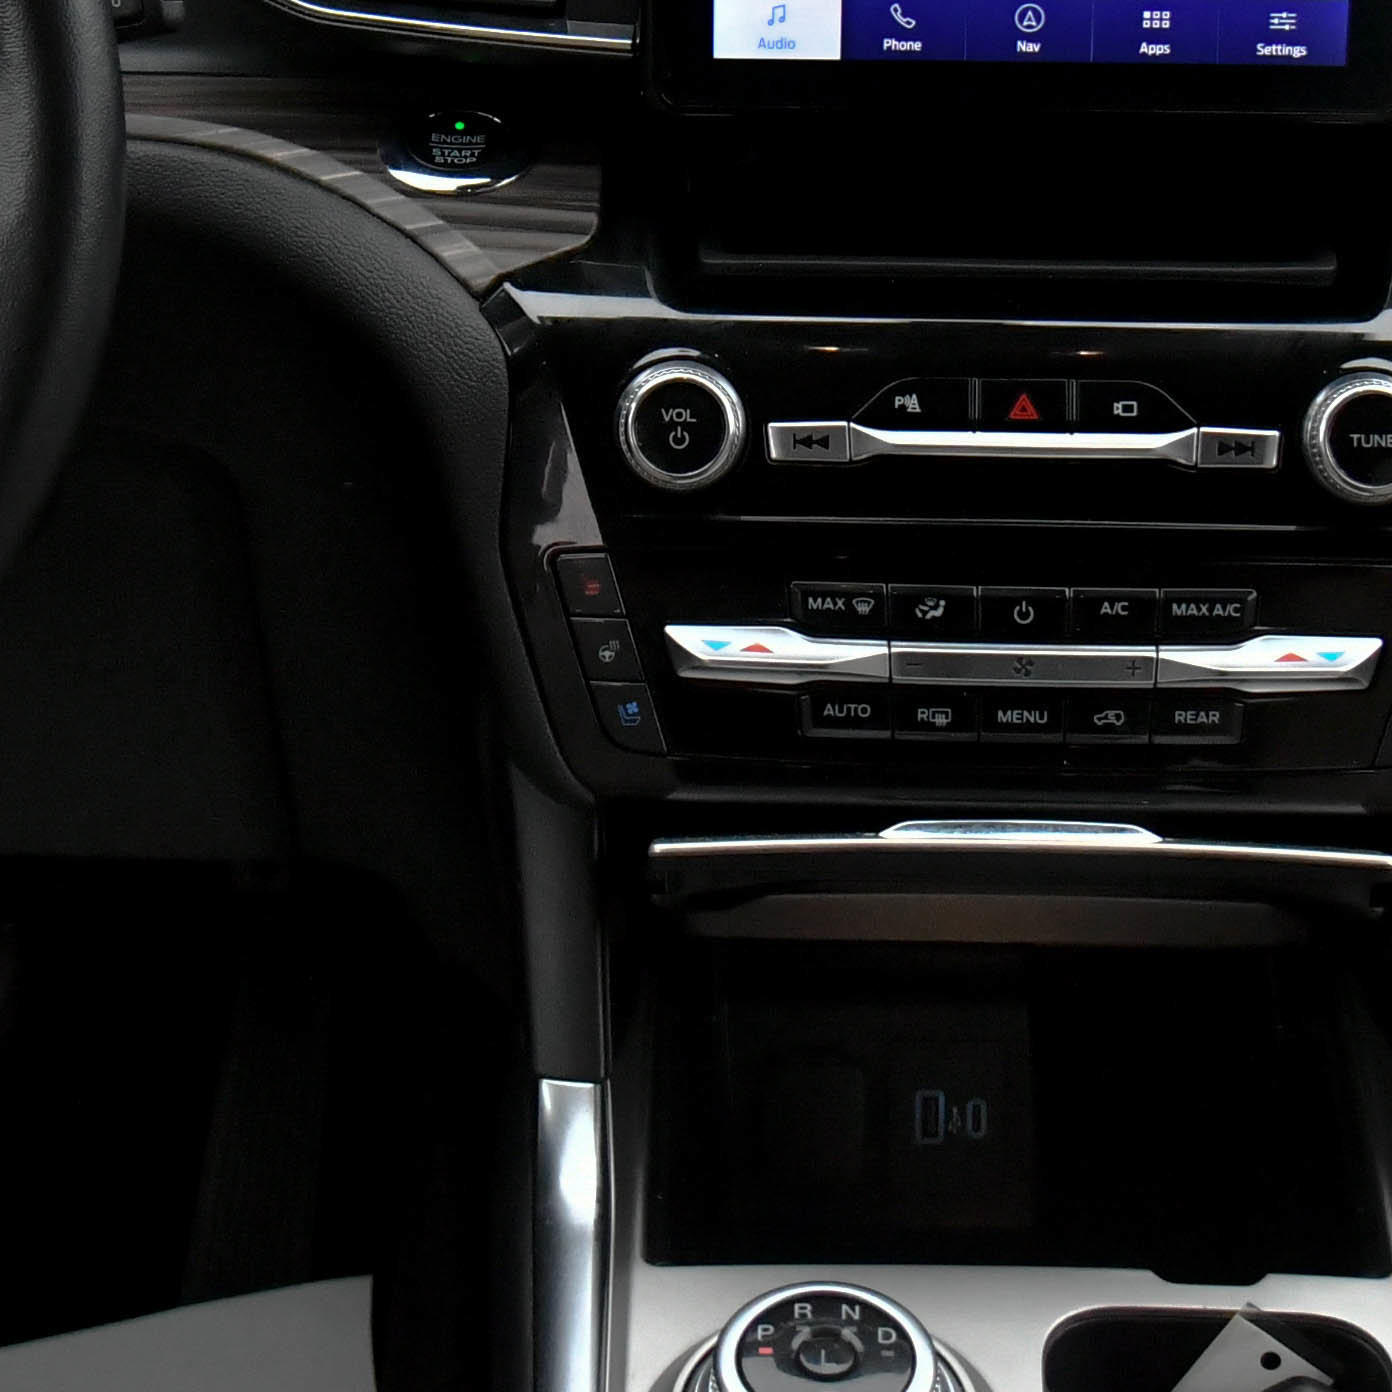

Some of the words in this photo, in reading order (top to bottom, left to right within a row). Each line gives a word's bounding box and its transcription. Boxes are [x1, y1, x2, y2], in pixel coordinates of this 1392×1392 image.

[757, 36, 796, 51] Audio
[883, 37, 922, 53] Phone
[1016, 40, 1041, 53] Nav
[1139, 41, 1171, 57] Apps
[1256, 42, 1307, 58] Settings
[431, 132, 486, 144] ENGINE
[431, 148, 482, 157] START
[434, 156, 477, 164] STOP
[661, 407, 697, 423] VOL
[808, 596, 846, 612] MAX
[1100, 602, 1129, 617] A/C
[1172, 603, 1210, 618] MAX
[1212, 603, 1241, 619] A/C
[823, 703, 871, 718] AUTO
[997, 709, 1048, 724] MENU
[1174, 710, 1220, 725] REAR
[794, 1302, 813, 1319] R
[841, 1303, 860, 1320] N
[757, 1324, 774, 1341] P
[877, 1327, 897, 1344] D
